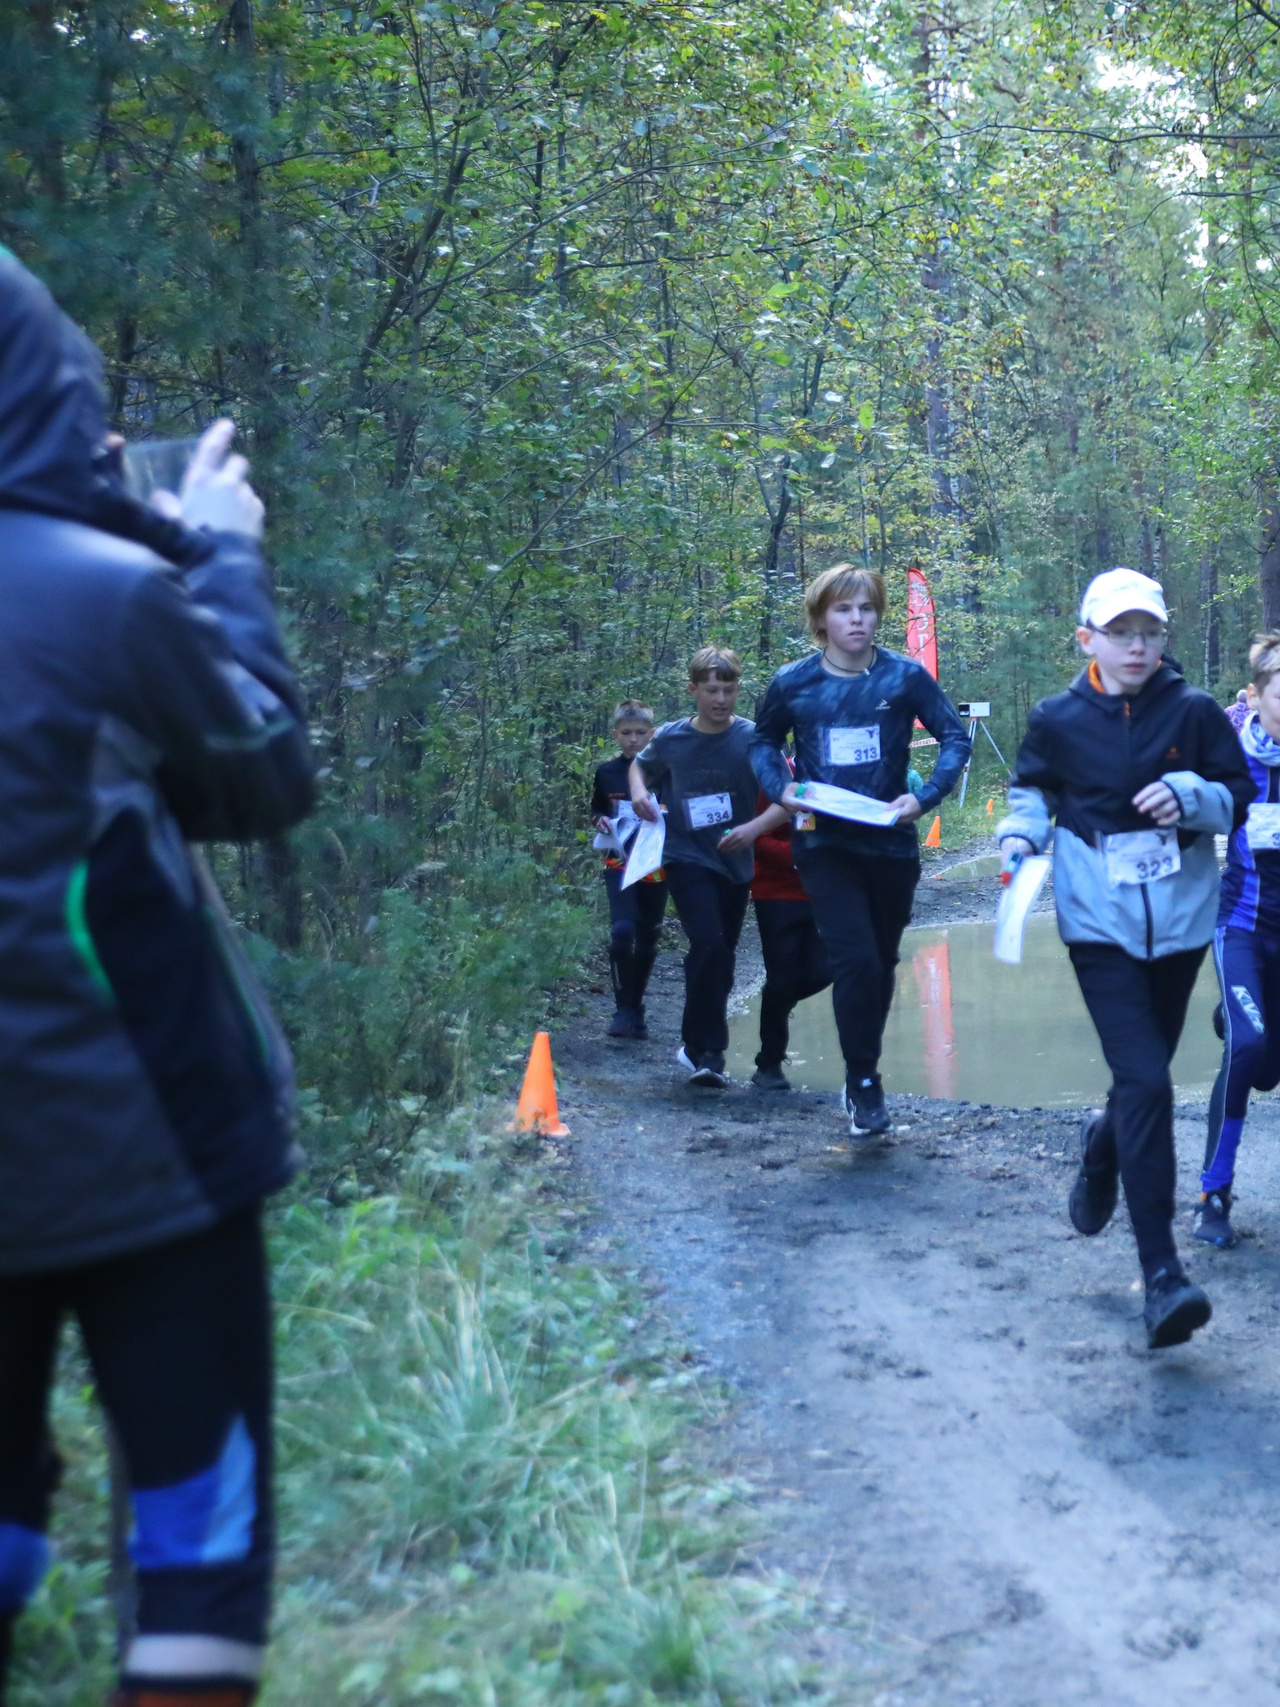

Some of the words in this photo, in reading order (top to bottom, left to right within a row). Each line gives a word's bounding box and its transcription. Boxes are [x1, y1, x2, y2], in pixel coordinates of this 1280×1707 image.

[854, 746, 877, 761] 313
[706, 809, 730, 824] 334
[1136, 855, 1173, 880] 323
